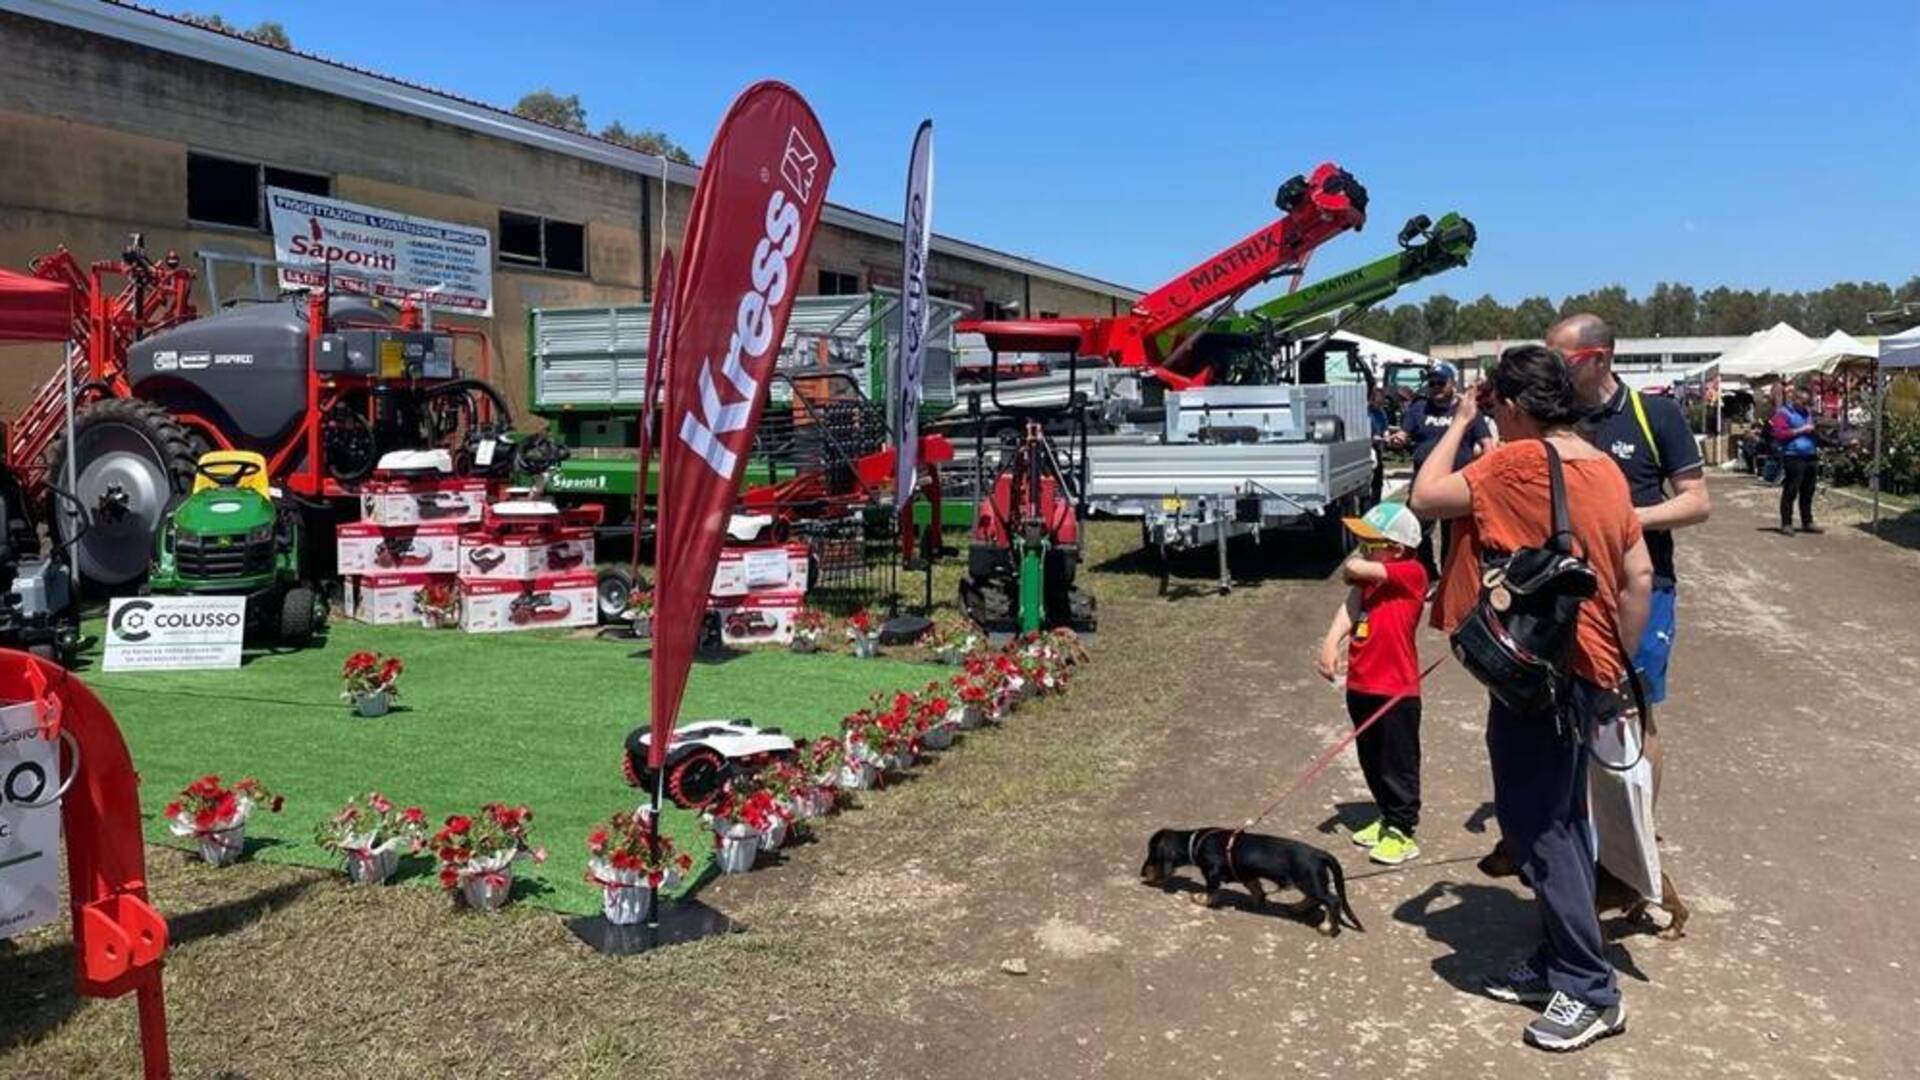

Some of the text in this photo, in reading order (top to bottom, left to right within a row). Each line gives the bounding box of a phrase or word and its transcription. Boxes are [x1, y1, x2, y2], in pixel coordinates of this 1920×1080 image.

[289, 234, 396, 271] Saporiti
[1189, 231, 1280, 293] MATRIX
[1315, 269, 1364, 293] MATRIX
[678, 190, 800, 480] Kress
[1425, 415, 1454, 427] PUM
[155, 613, 241, 627] COLUSSO
